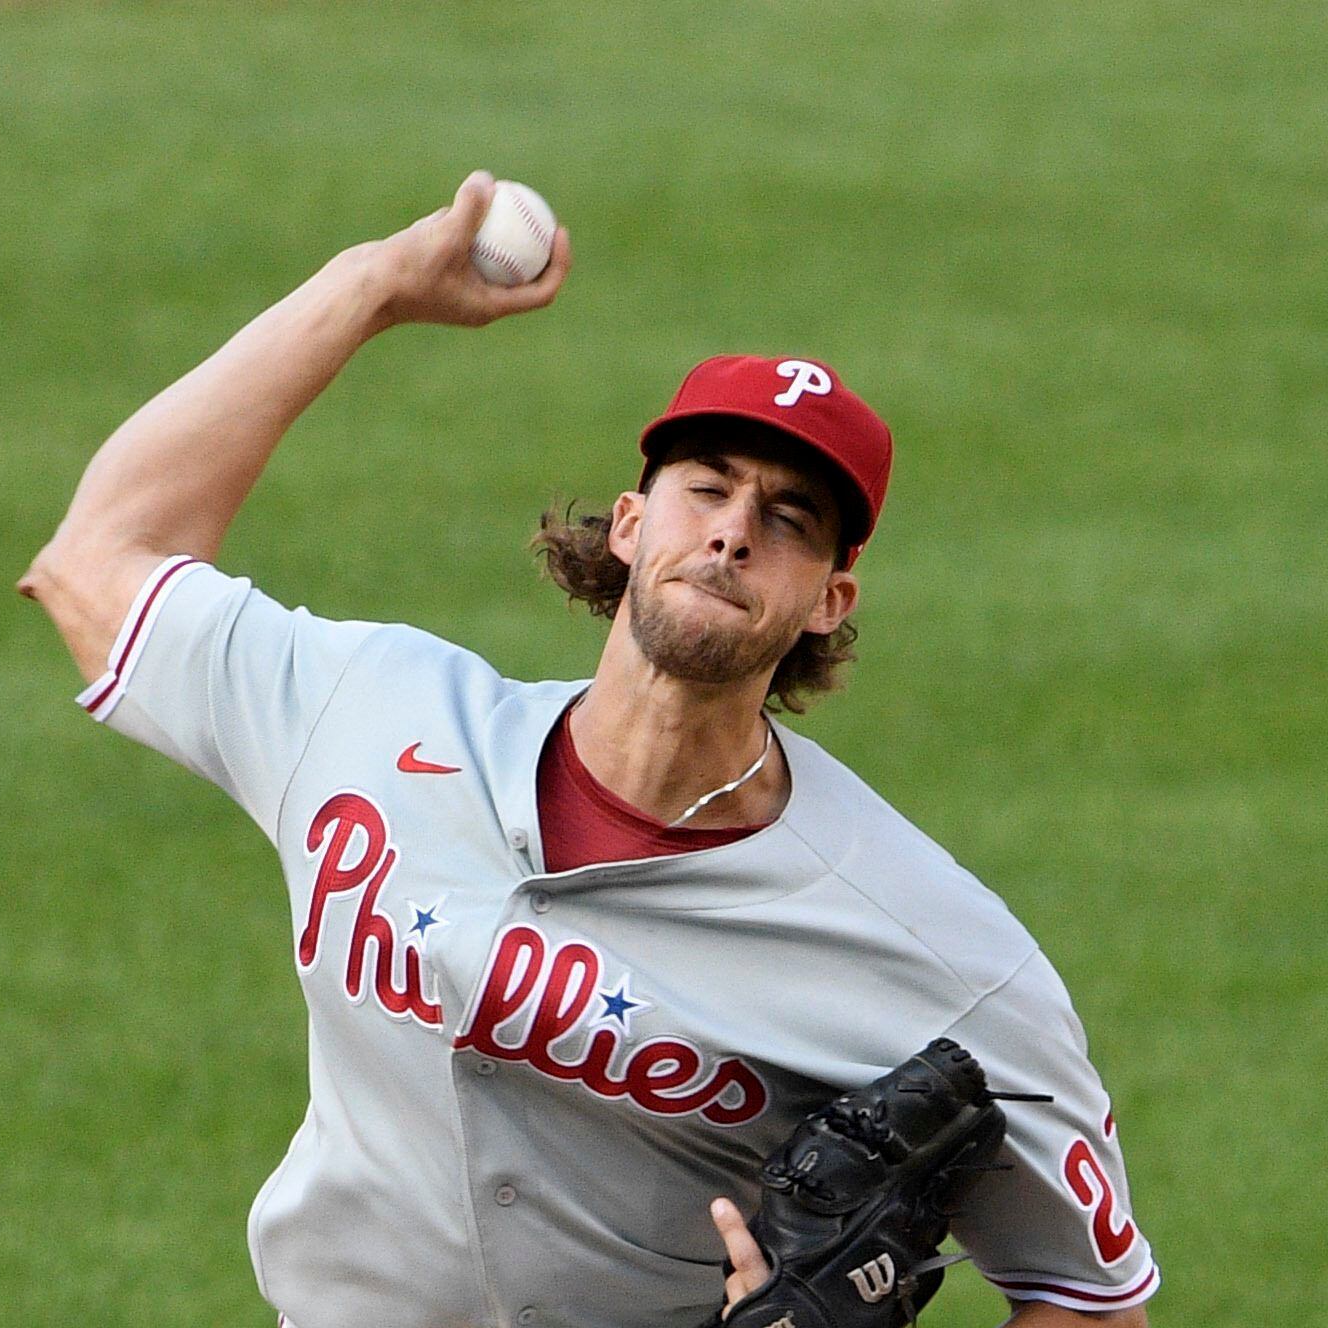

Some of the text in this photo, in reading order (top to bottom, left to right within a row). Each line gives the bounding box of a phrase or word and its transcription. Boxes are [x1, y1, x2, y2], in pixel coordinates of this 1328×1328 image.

[773, 359, 833, 408] P
[297, 786, 770, 1127] Phillies
[1060, 1111, 1137, 1268] 2
[846, 1252, 895, 1303] W
